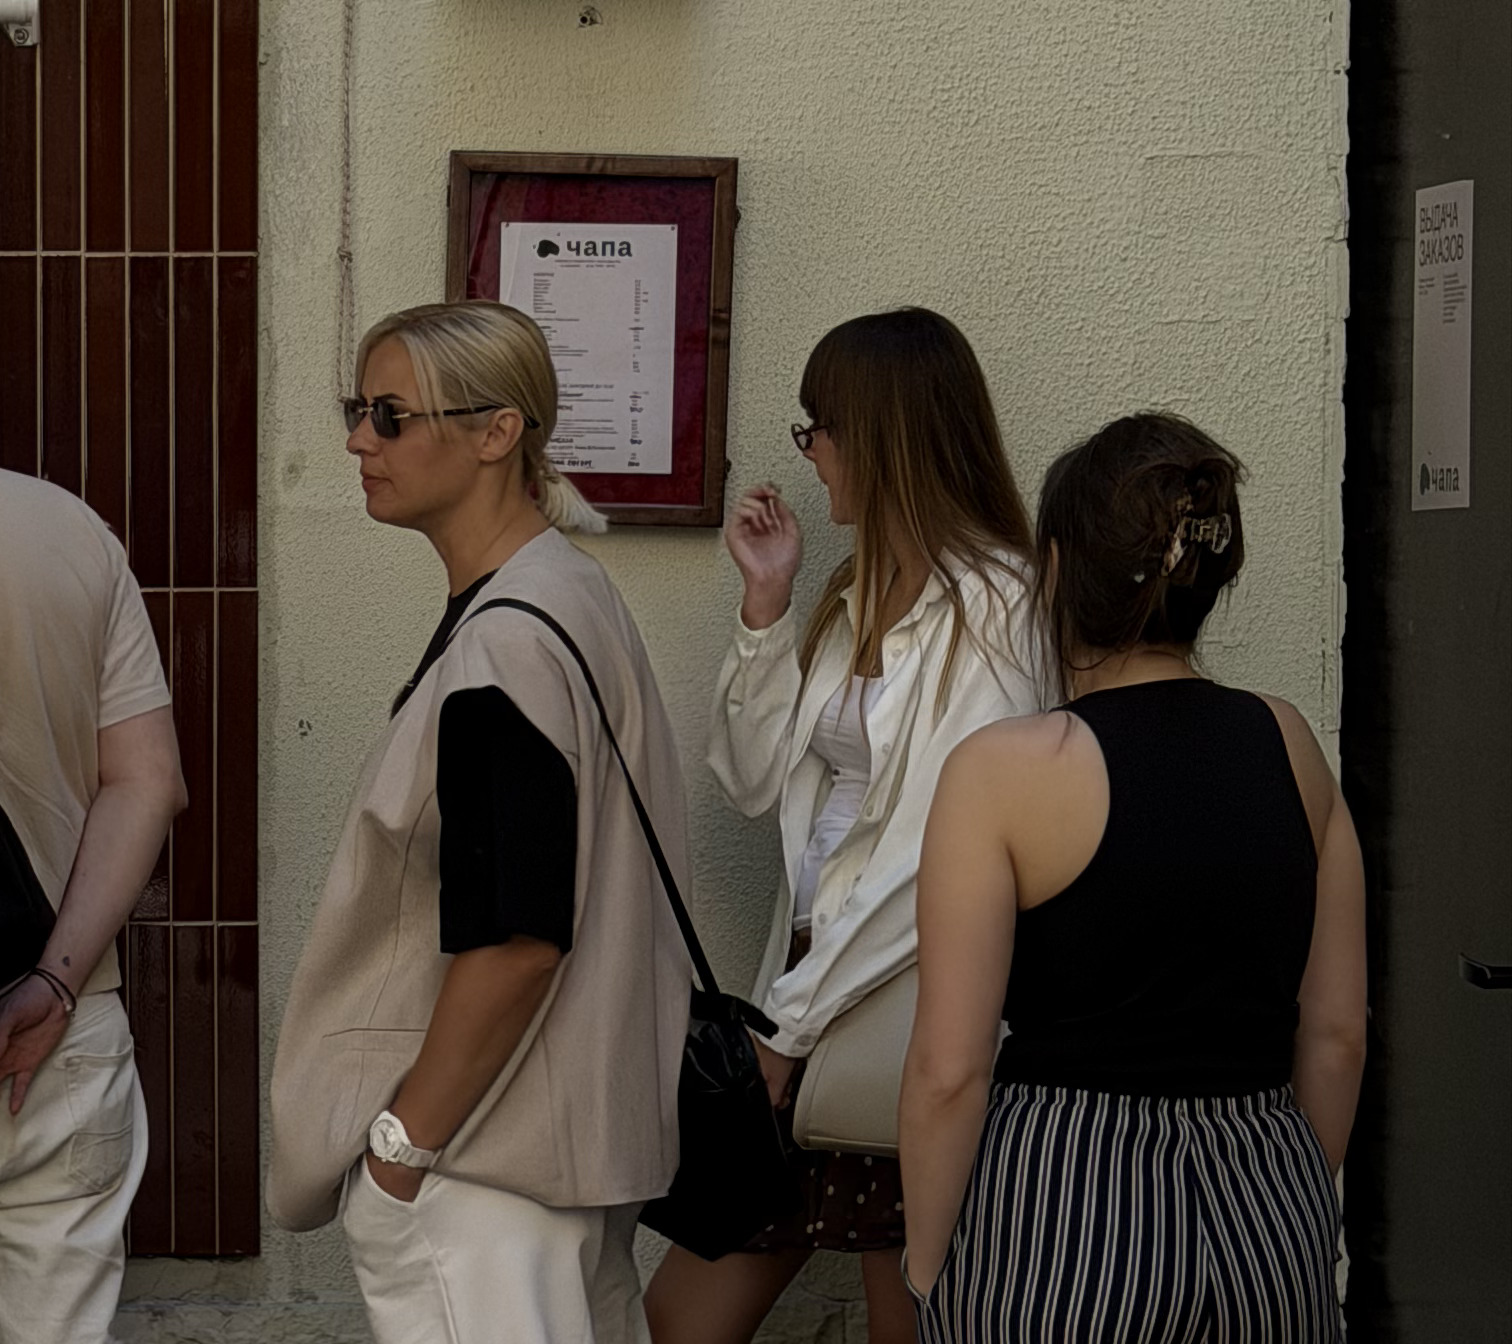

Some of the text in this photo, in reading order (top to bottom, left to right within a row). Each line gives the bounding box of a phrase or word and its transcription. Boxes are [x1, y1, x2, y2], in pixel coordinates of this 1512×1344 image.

[1419, 202, 1459, 235] ВЫДАЧА
[567, 240, 632, 257] чапа
[1419, 233, 1465, 267] ЗАКАЗОВ
[1431, 467, 1460, 492] чапа
